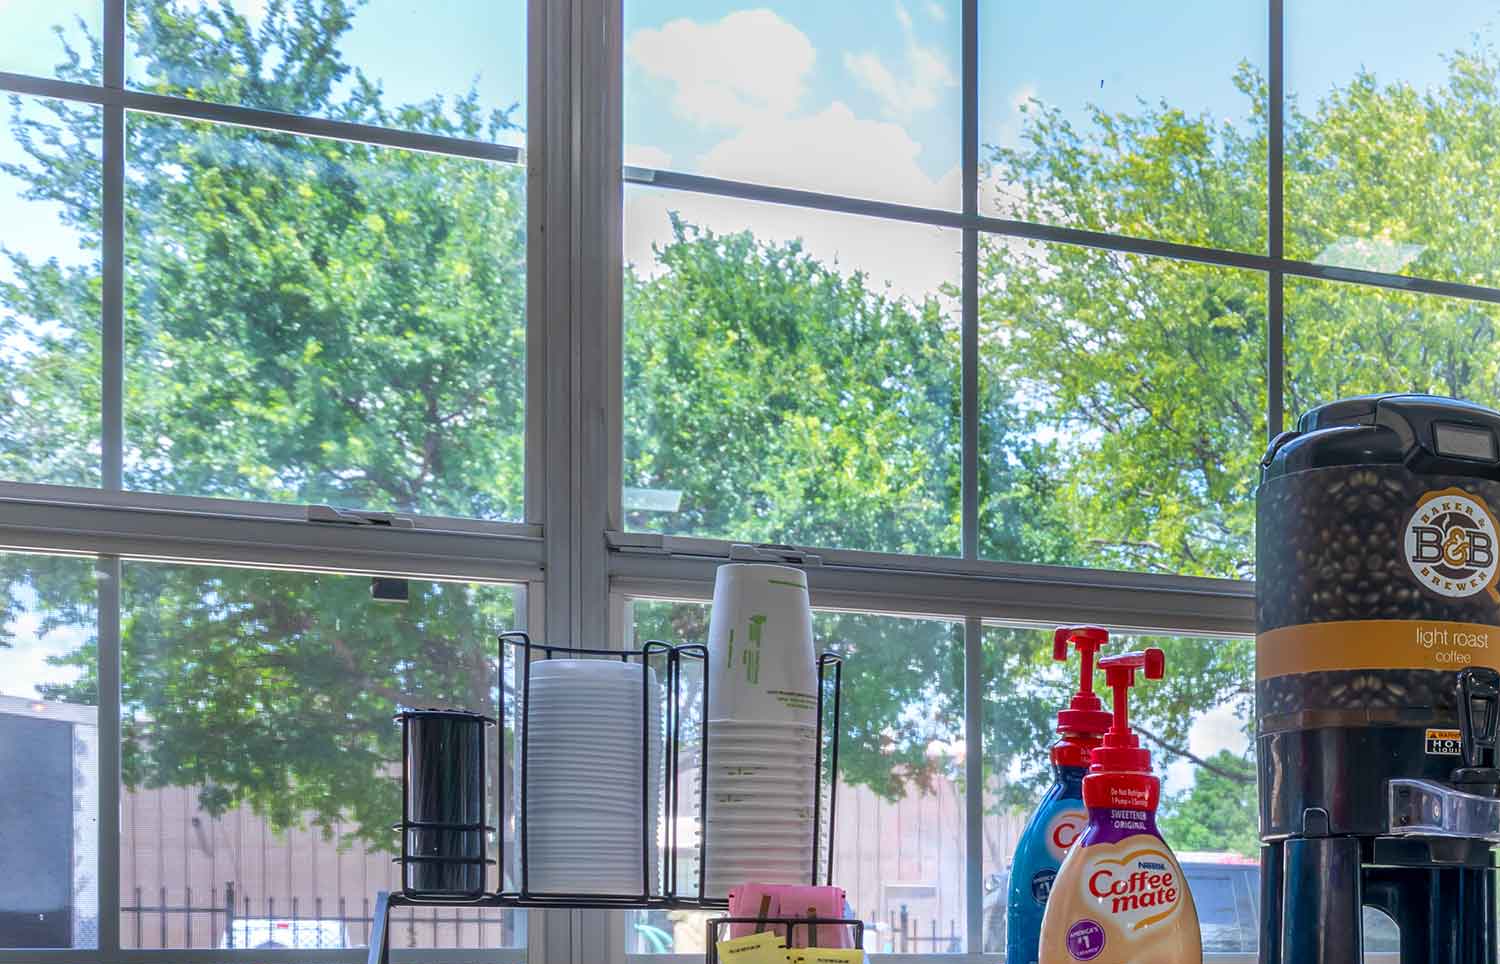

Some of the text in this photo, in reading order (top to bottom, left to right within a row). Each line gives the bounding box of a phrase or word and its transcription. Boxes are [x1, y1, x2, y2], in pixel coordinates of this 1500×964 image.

[1421, 502, 1474, 524] BAKER
[1412, 526, 1493, 568] B&B
[1420, 567, 1488, 591] BREWER
[1416, 627, 1489, 649] light roast
[1435, 650, 1472, 664] coffee
[1089, 869, 1172, 898] Coffee
[1112, 888, 1177, 913] mate
